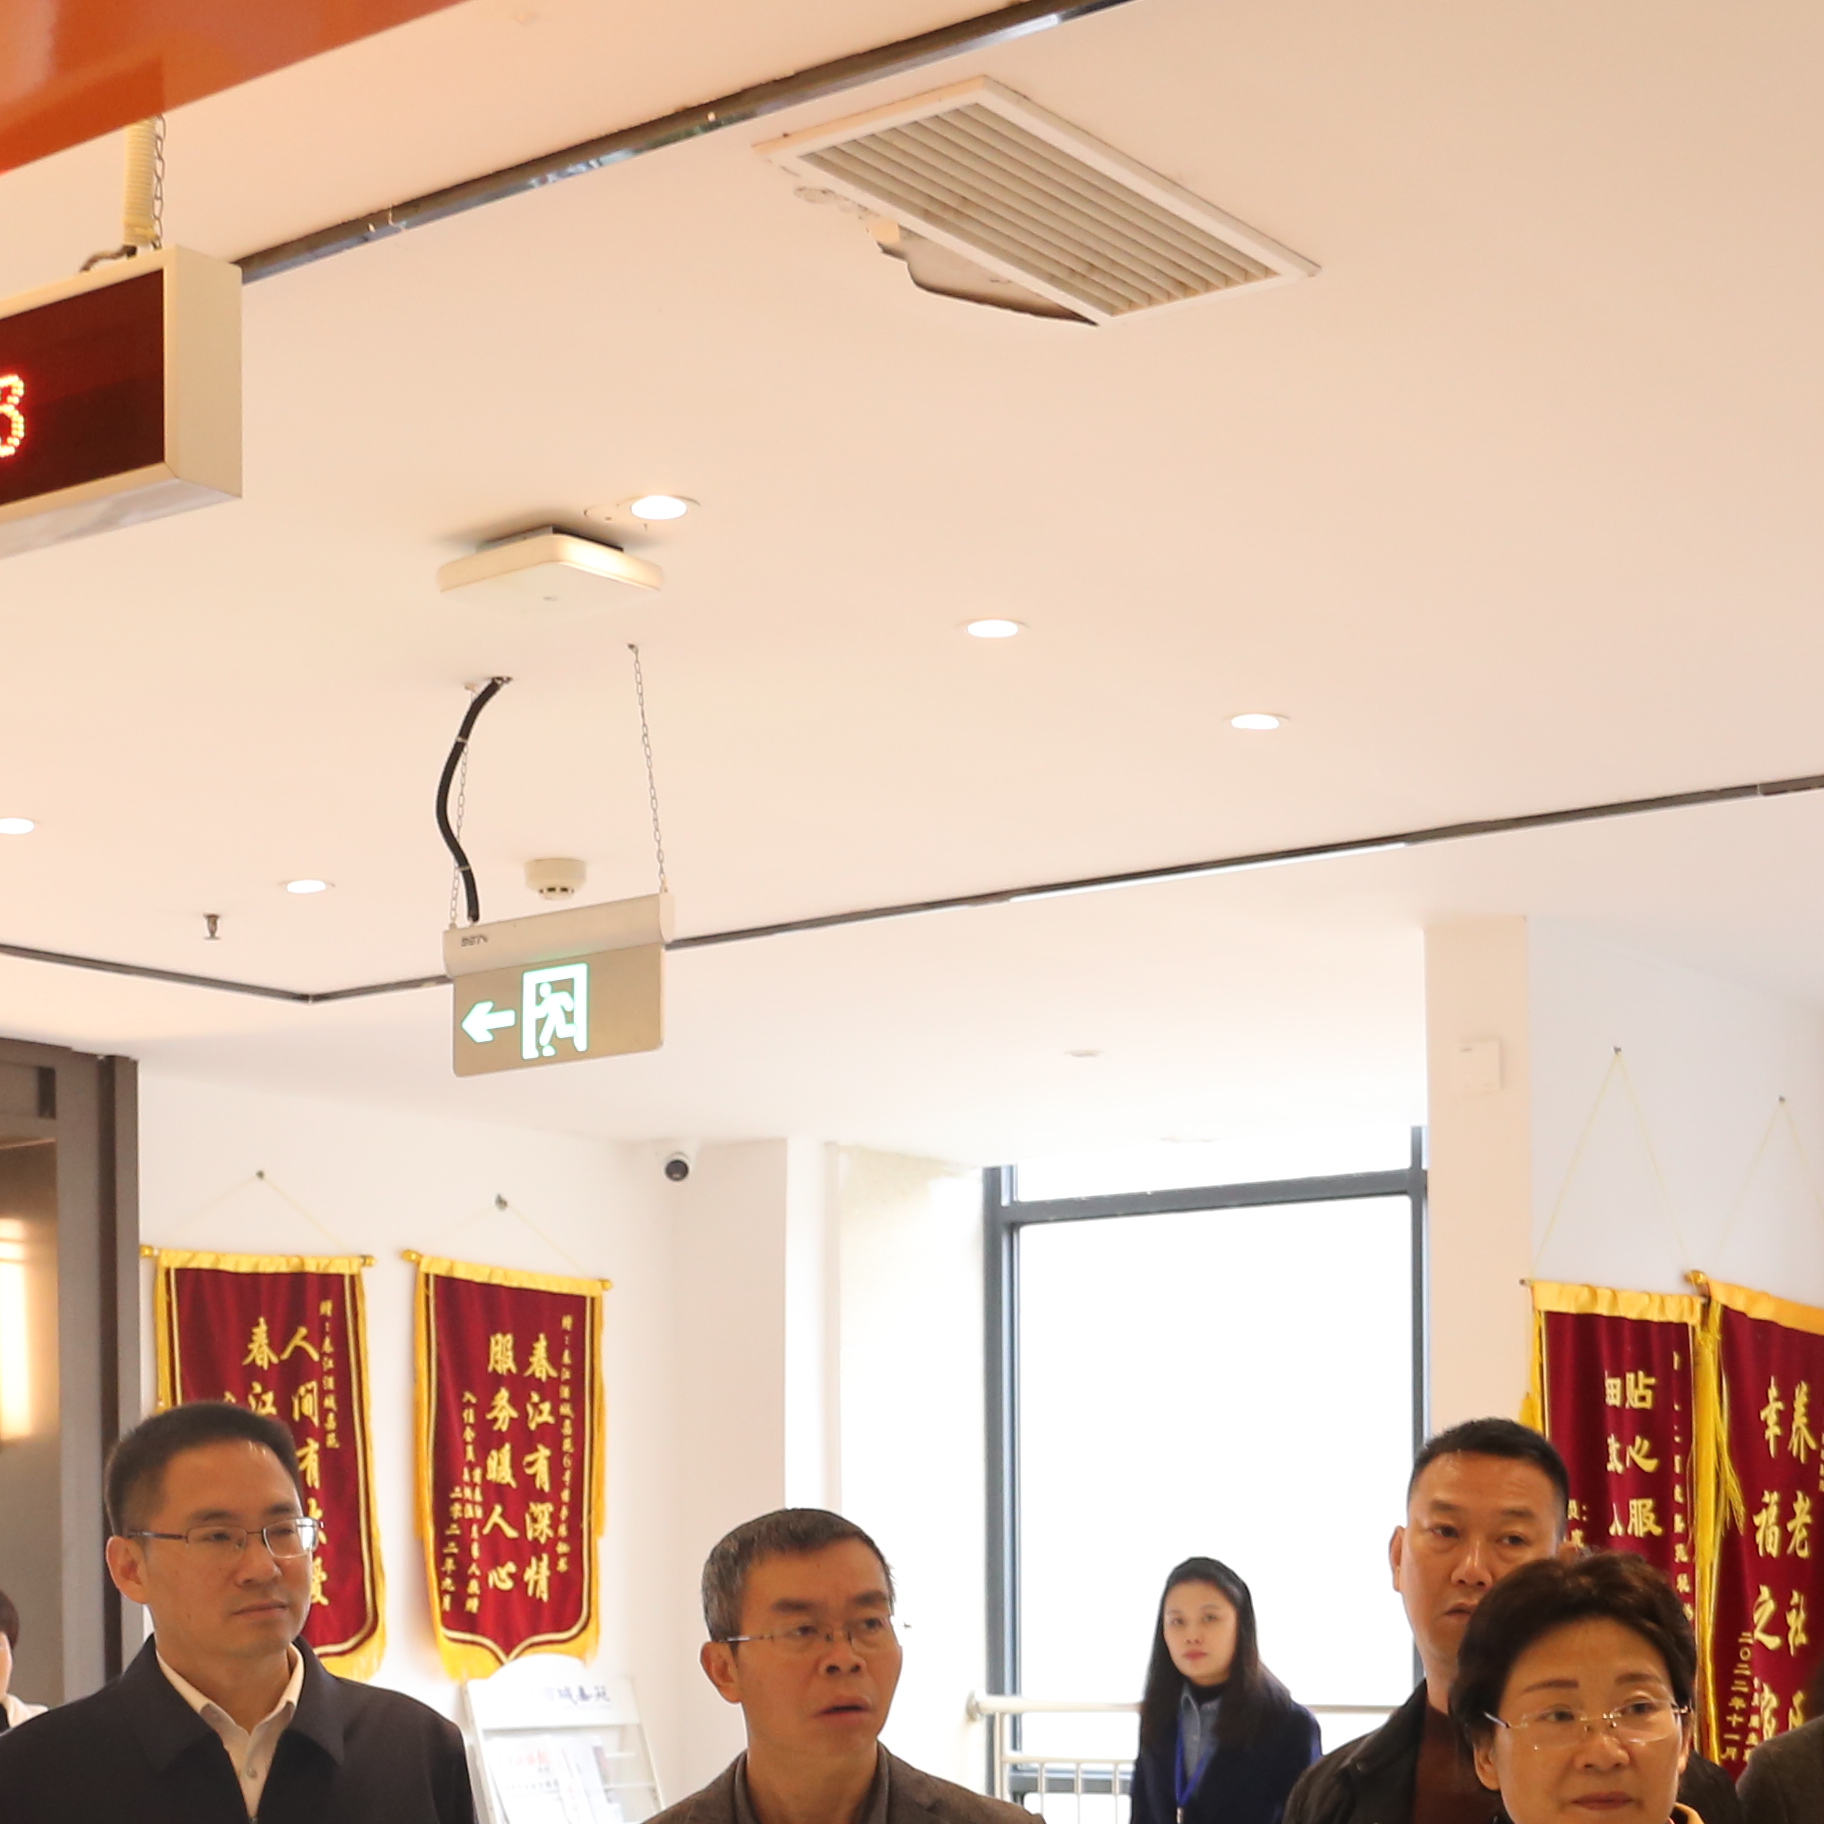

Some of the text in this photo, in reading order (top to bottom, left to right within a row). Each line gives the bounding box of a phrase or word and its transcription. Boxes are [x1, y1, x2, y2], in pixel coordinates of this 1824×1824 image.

[242, 1316, 280, 1417] 春江
[480, 1332, 520, 1592] 服务暖人心
[522, 1332, 560, 1603] 春江有深情
